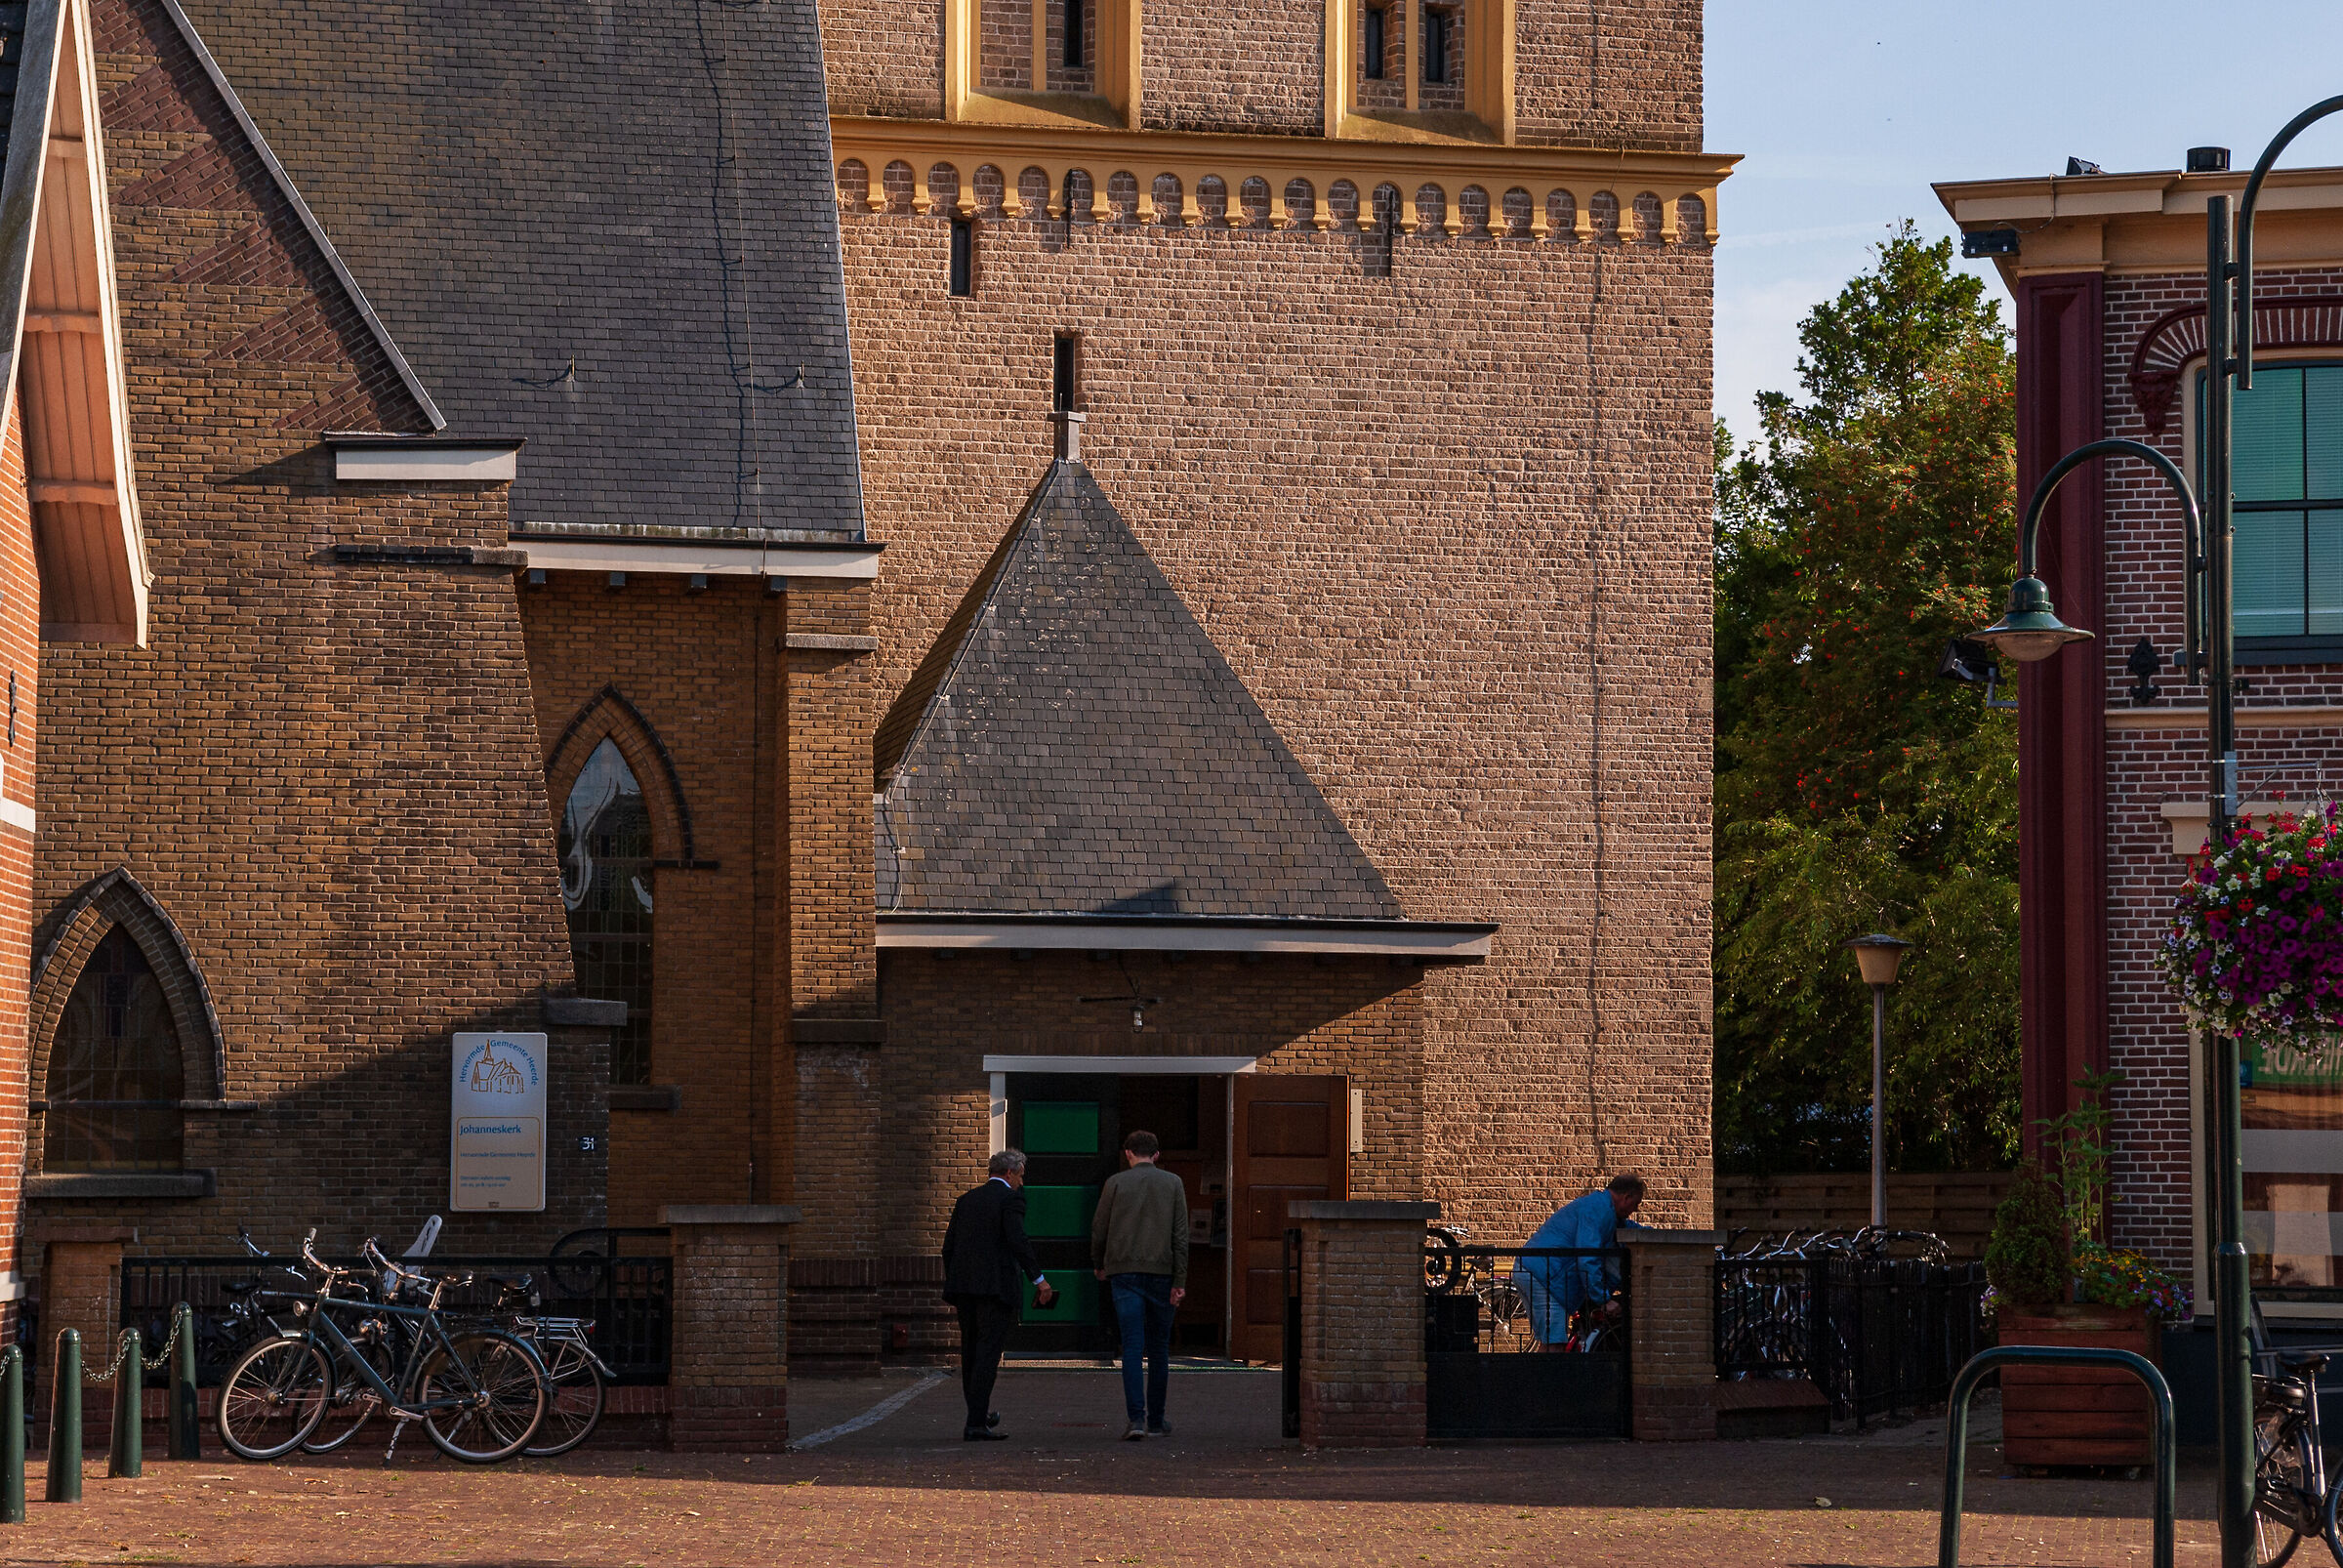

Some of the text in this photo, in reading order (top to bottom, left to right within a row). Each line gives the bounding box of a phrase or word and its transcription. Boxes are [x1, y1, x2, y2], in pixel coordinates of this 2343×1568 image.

[460, 1040, 539, 1086] Hervormde Gemeente Heerde
[459, 1125, 521, 1135] Johanneskerk
[582, 1137, 595, 1150] 31
